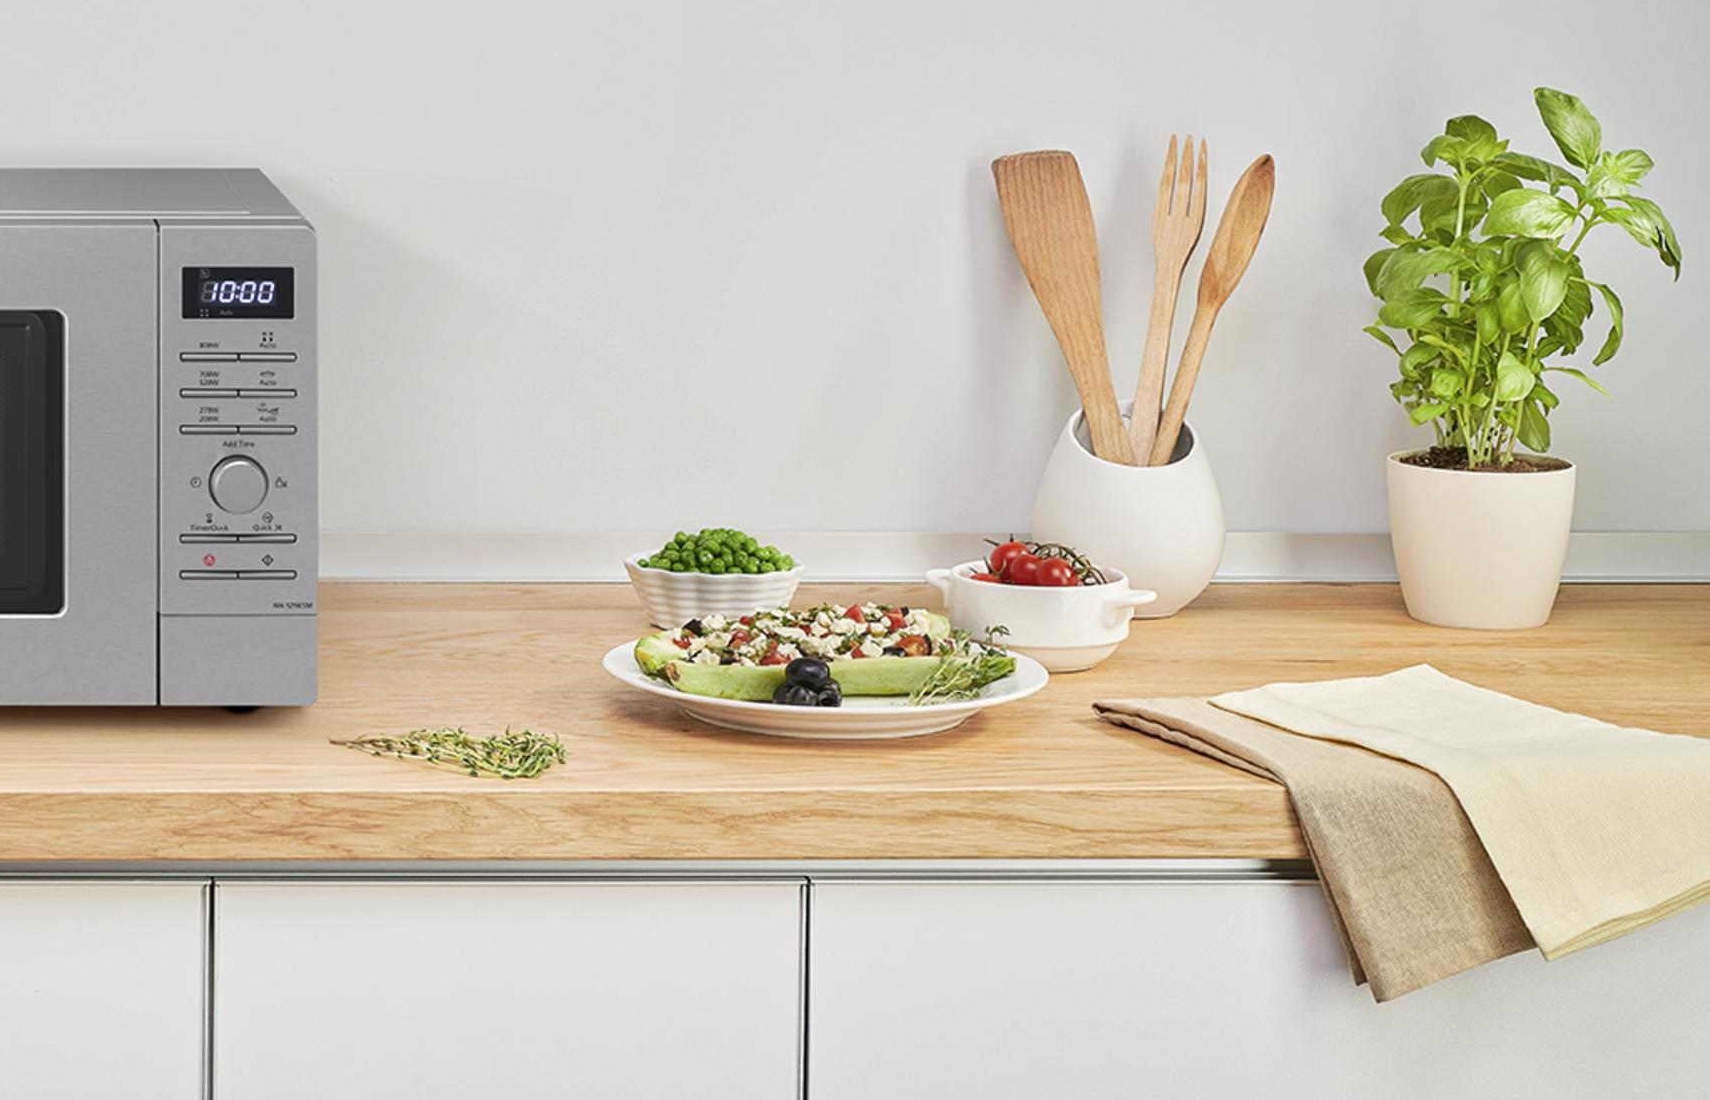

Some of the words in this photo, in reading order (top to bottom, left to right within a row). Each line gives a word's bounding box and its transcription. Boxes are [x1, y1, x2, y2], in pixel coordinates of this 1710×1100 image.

[210, 281, 275, 303] 10:00
[222, 440, 237, 448] Add
[238, 440, 255, 448] Time
[252, 524, 272, 532] Quick
